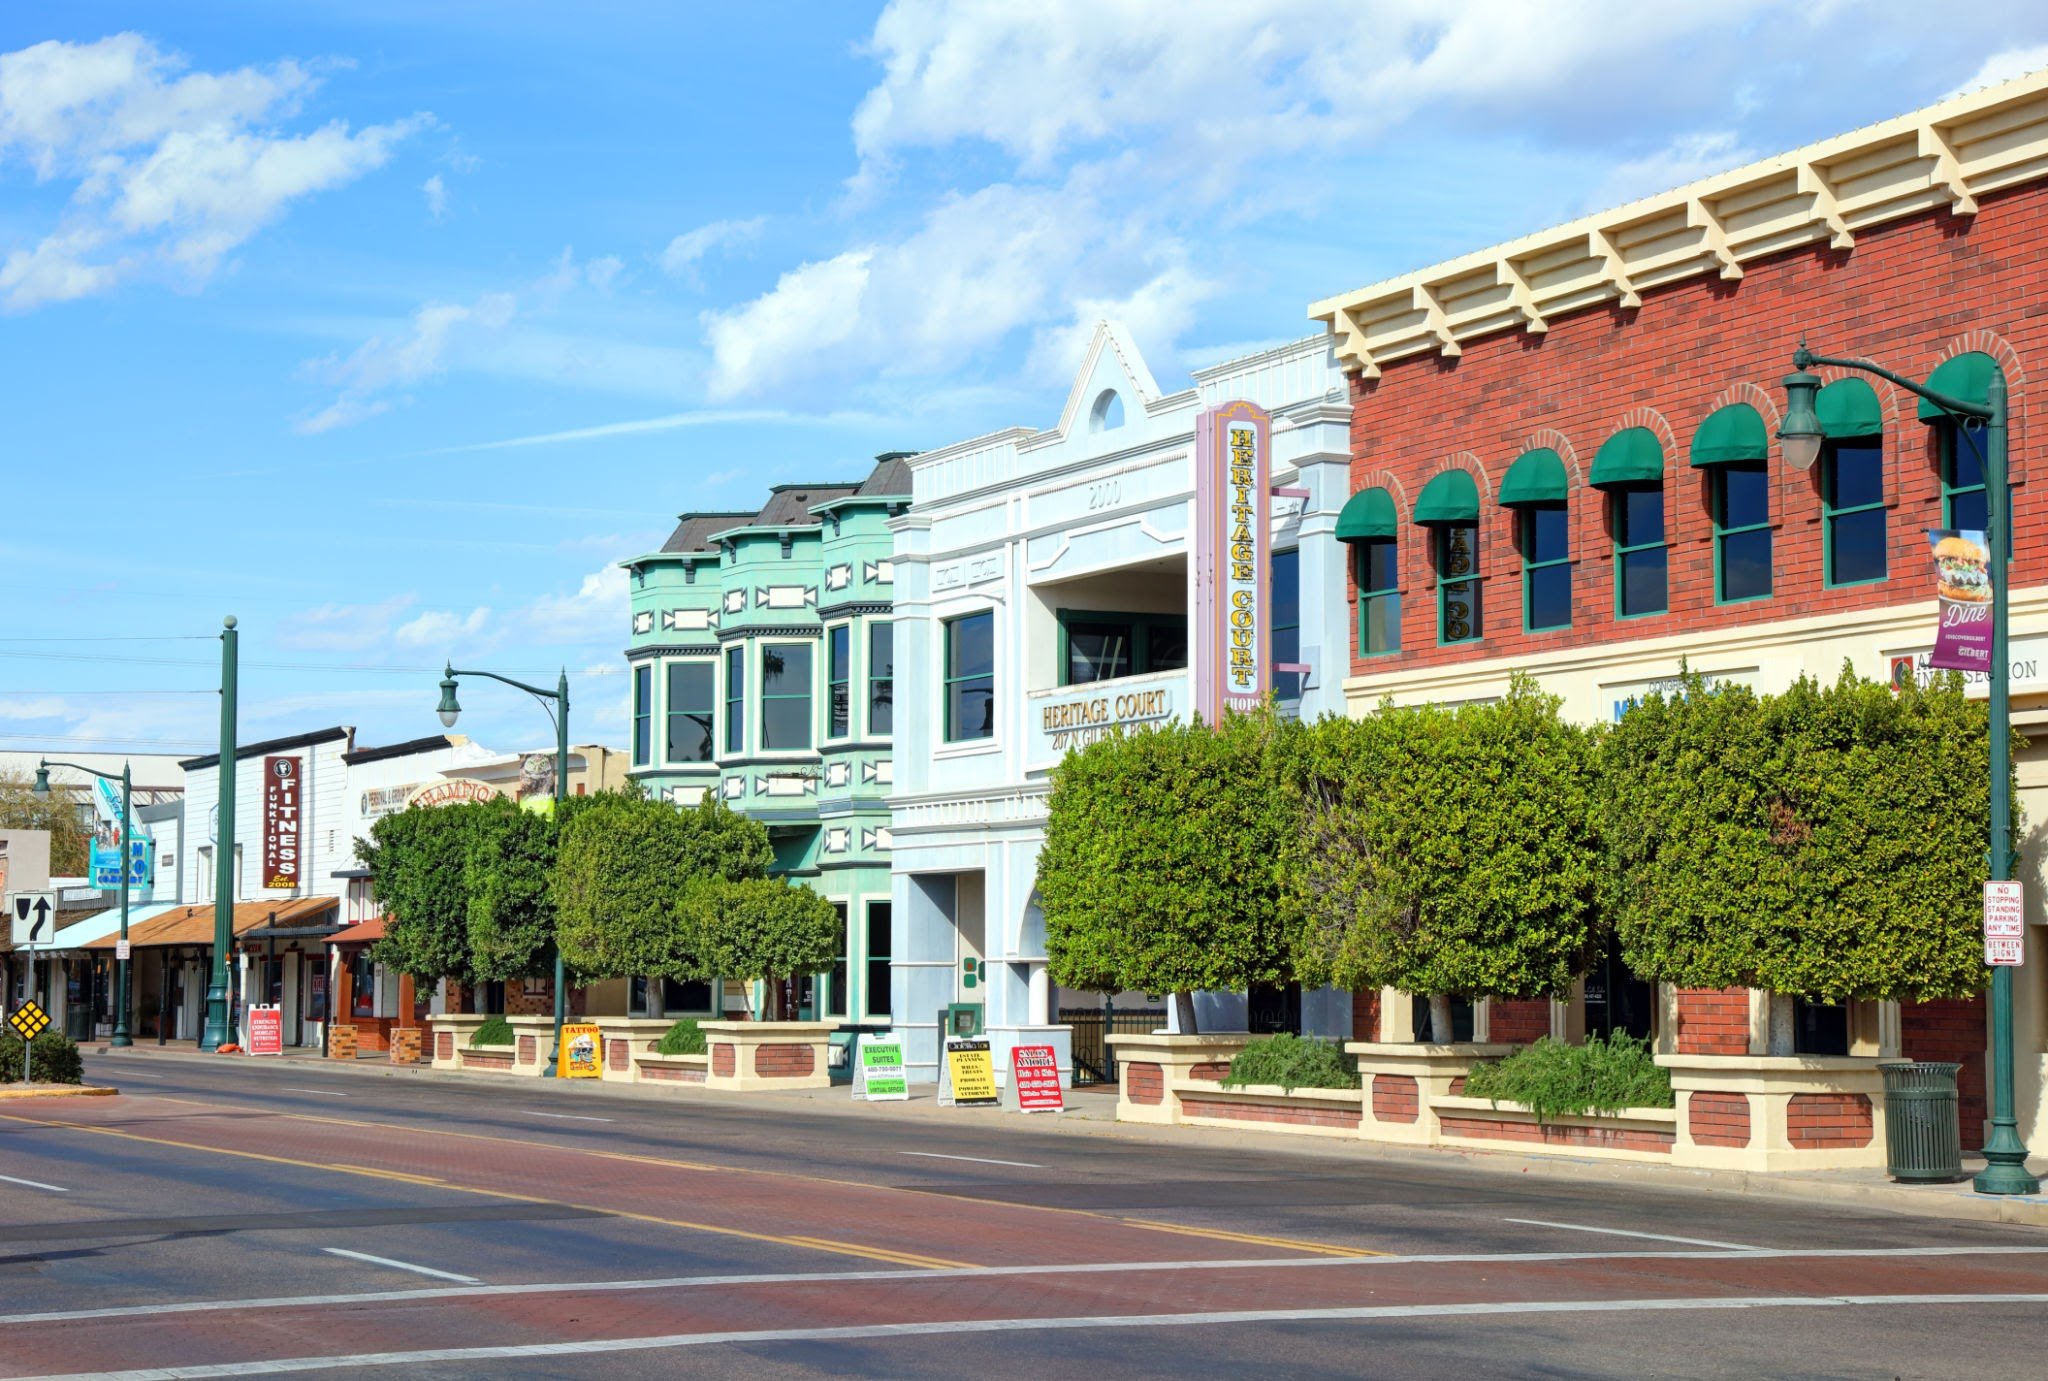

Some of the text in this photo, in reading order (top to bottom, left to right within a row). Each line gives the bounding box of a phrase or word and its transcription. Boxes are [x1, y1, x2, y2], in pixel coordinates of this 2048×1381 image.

[1089, 480, 1121, 510] 2000
[1230, 428, 1255, 686] HERITAGE COURT
[1943, 603, 1987, 628] Dine
[1958, 647, 1989, 658] GILBERT
[1043, 689, 1166, 730] HERITAGE COURT
[1052, 732, 1069, 750] 207
[268, 785, 278, 867] FUNKTIONAL
[279, 778, 296, 874] FITNESS
[1987, 896, 2019, 904] STOPPING
[2005, 924, 2019, 932] TIME
[872, 1055, 895, 1063] SUITES
[1019, 1049, 1048, 1057] SALON
